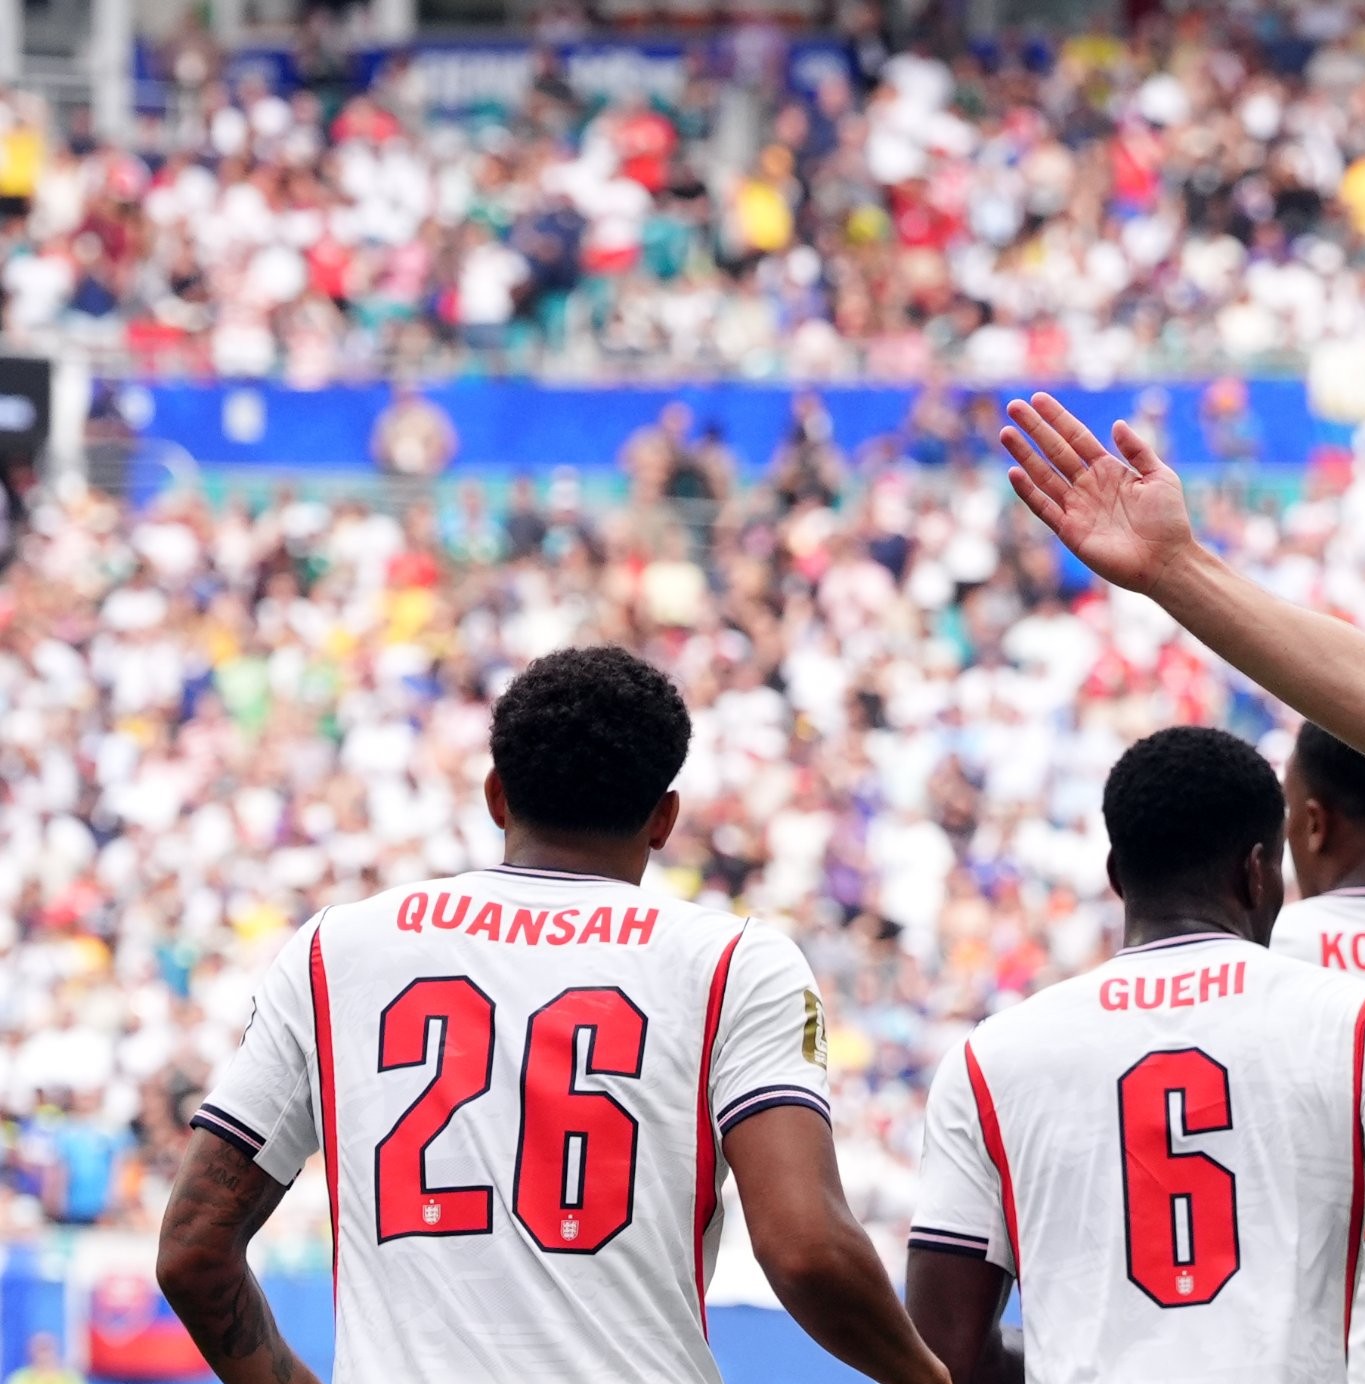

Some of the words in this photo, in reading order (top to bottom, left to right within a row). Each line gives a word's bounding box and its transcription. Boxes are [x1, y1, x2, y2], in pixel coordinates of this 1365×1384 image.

[396, 892, 659, 946] QUANSAH
[1100, 961, 1246, 1011] GUEHI
[375, 975, 648, 1255] 26
[1117, 1046, 1241, 1308] 6
